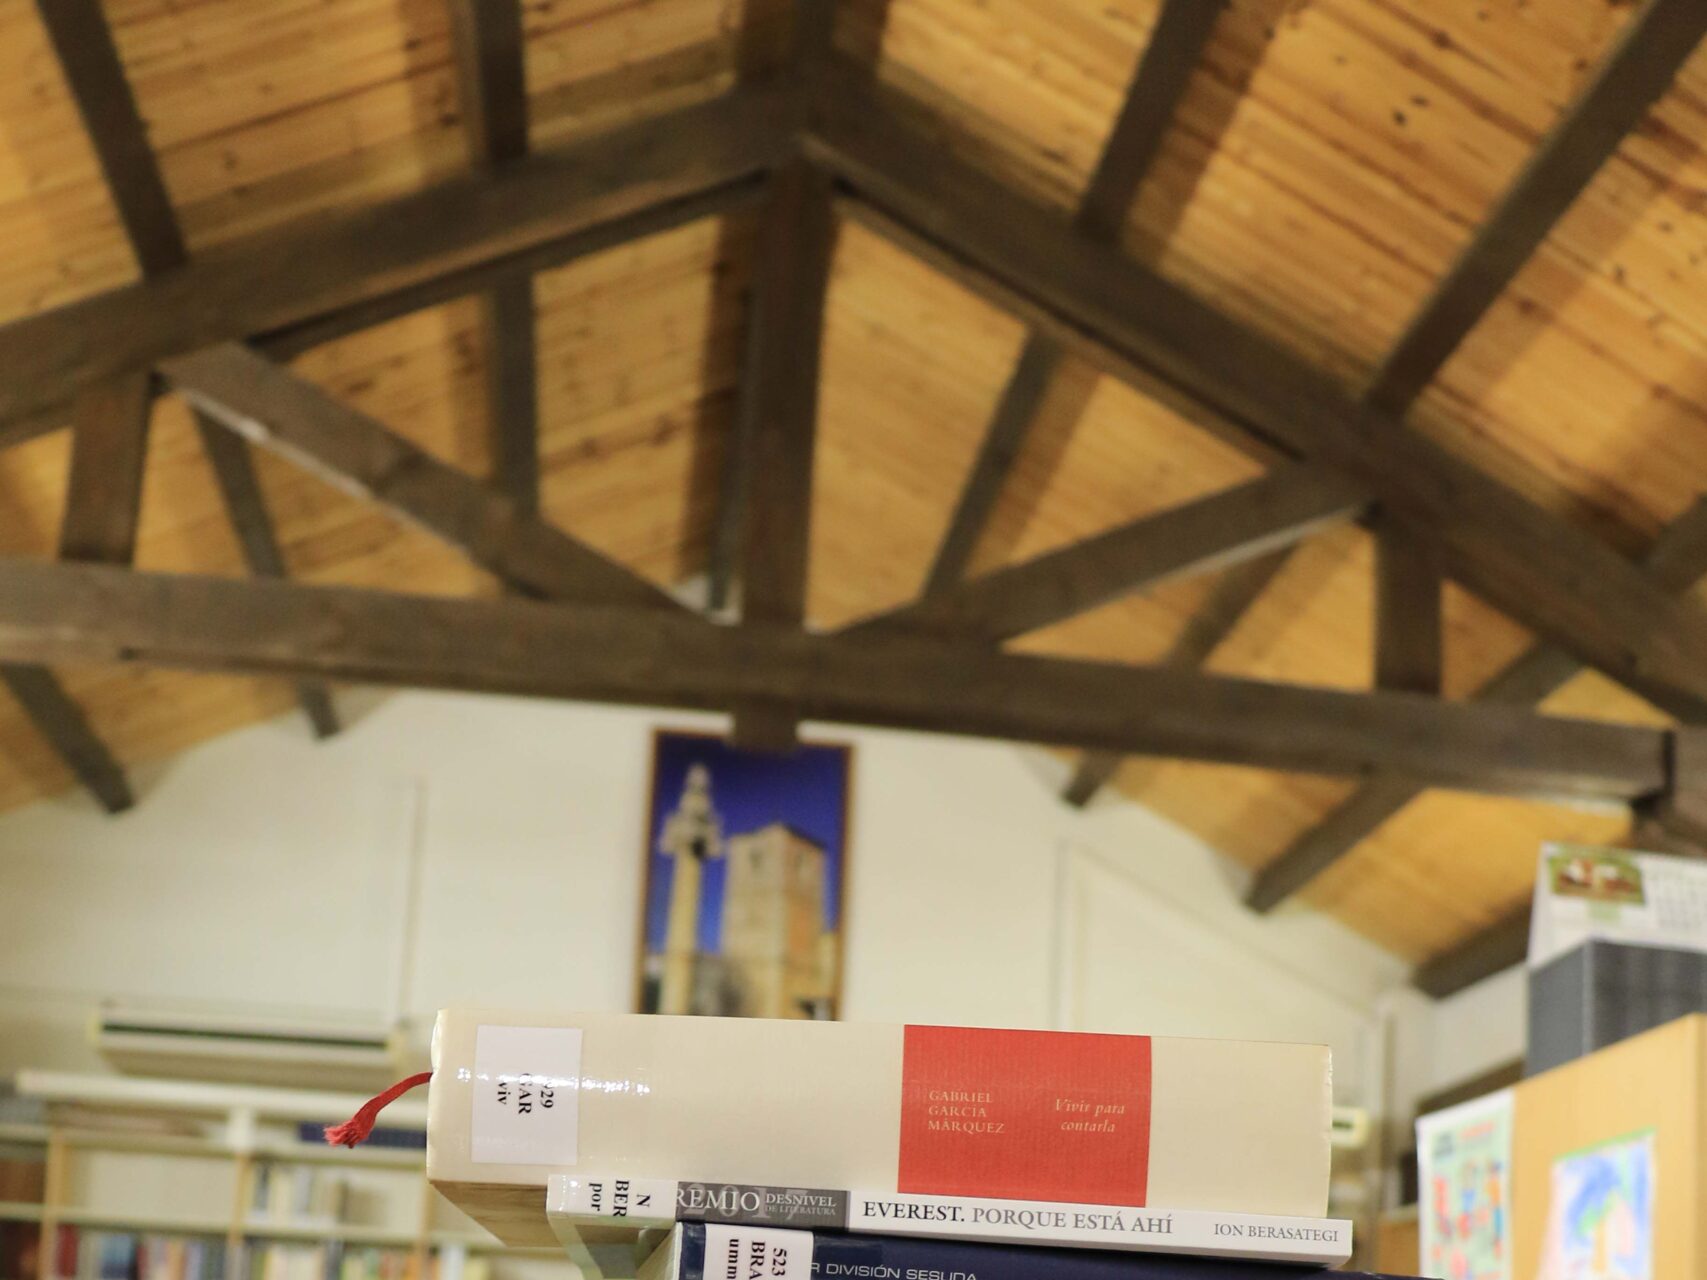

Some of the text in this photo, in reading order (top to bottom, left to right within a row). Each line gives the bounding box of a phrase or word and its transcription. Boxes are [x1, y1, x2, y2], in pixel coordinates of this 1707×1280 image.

[929, 1090, 993, 1103] GABRIEL
[1055, 1098, 1126, 1117] Vivir para
[928, 1119, 1006, 1135] MÁRQUEZ
[1060, 1119, 1116, 1133] contarla
[588, 1183, 603, 1211] por
[612, 1180, 630, 1218] BER
[636, 1194, 651, 1207] N
[766, 1192, 838, 1208] DESNIVEL
[863, 1200, 1174, 1236] EVEREST. PORQUE ESTÁ AHÍ
[1214, 1222, 1339, 1244] ION BERASATEGI
[726, 1238, 740, 1280] umm
[749, 1240, 766, 1280] BRA
[773, 1247, 788, 1276] 523
[826, 1262, 901, 1280] DIVISIÓN
